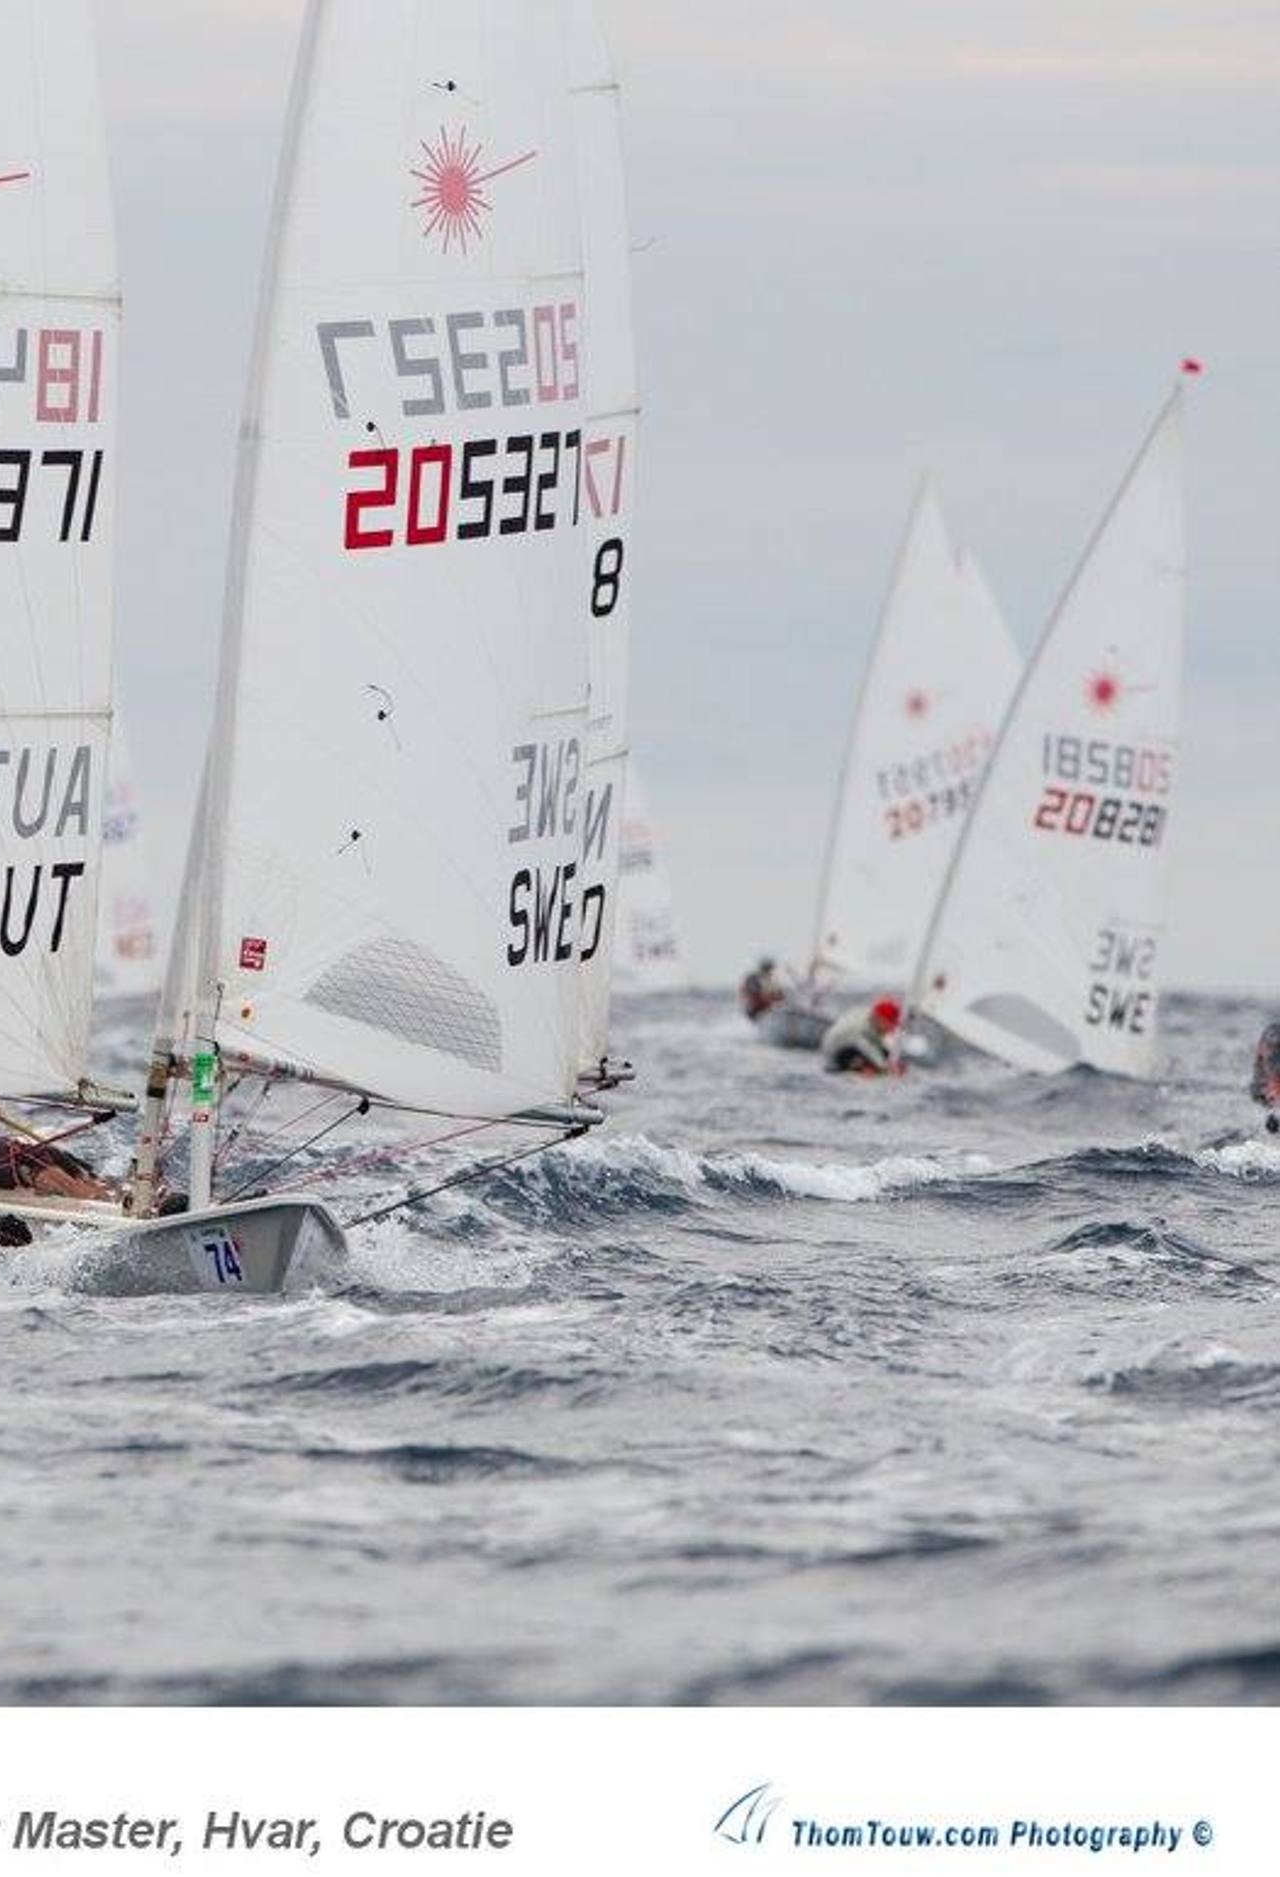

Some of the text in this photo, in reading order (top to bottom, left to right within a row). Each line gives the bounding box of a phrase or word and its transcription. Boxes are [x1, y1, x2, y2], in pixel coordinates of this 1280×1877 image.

[344, 429, 581, 550] 205327
[507, 863, 577, 966] SWE
[1086, 984, 1150, 1035] SWE
[204, 1240, 243, 1283] 74
